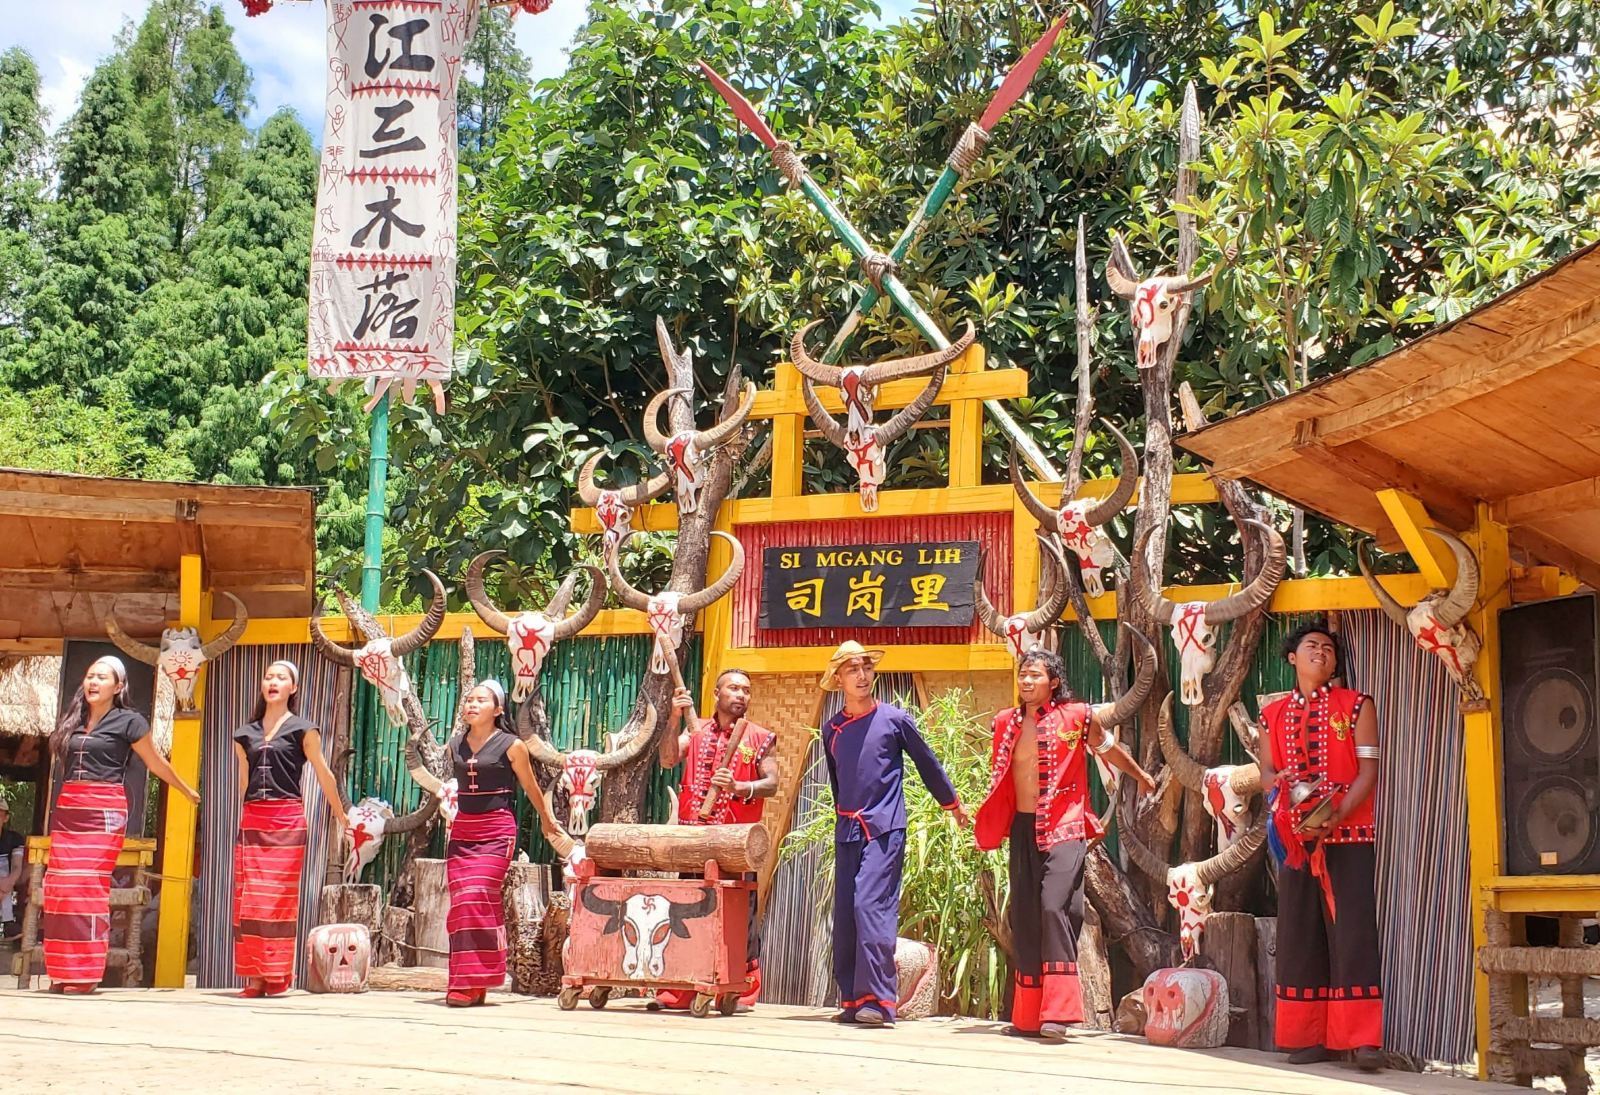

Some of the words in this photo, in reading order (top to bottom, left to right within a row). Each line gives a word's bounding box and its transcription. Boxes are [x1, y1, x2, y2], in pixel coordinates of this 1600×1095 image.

[350, 13, 435, 340] 江三木落
[780, 552, 801, 569] SI
[816, 549, 903, 568] MGANG
[918, 548, 961, 564] LIH
[785, 570, 950, 621] 司岗里
